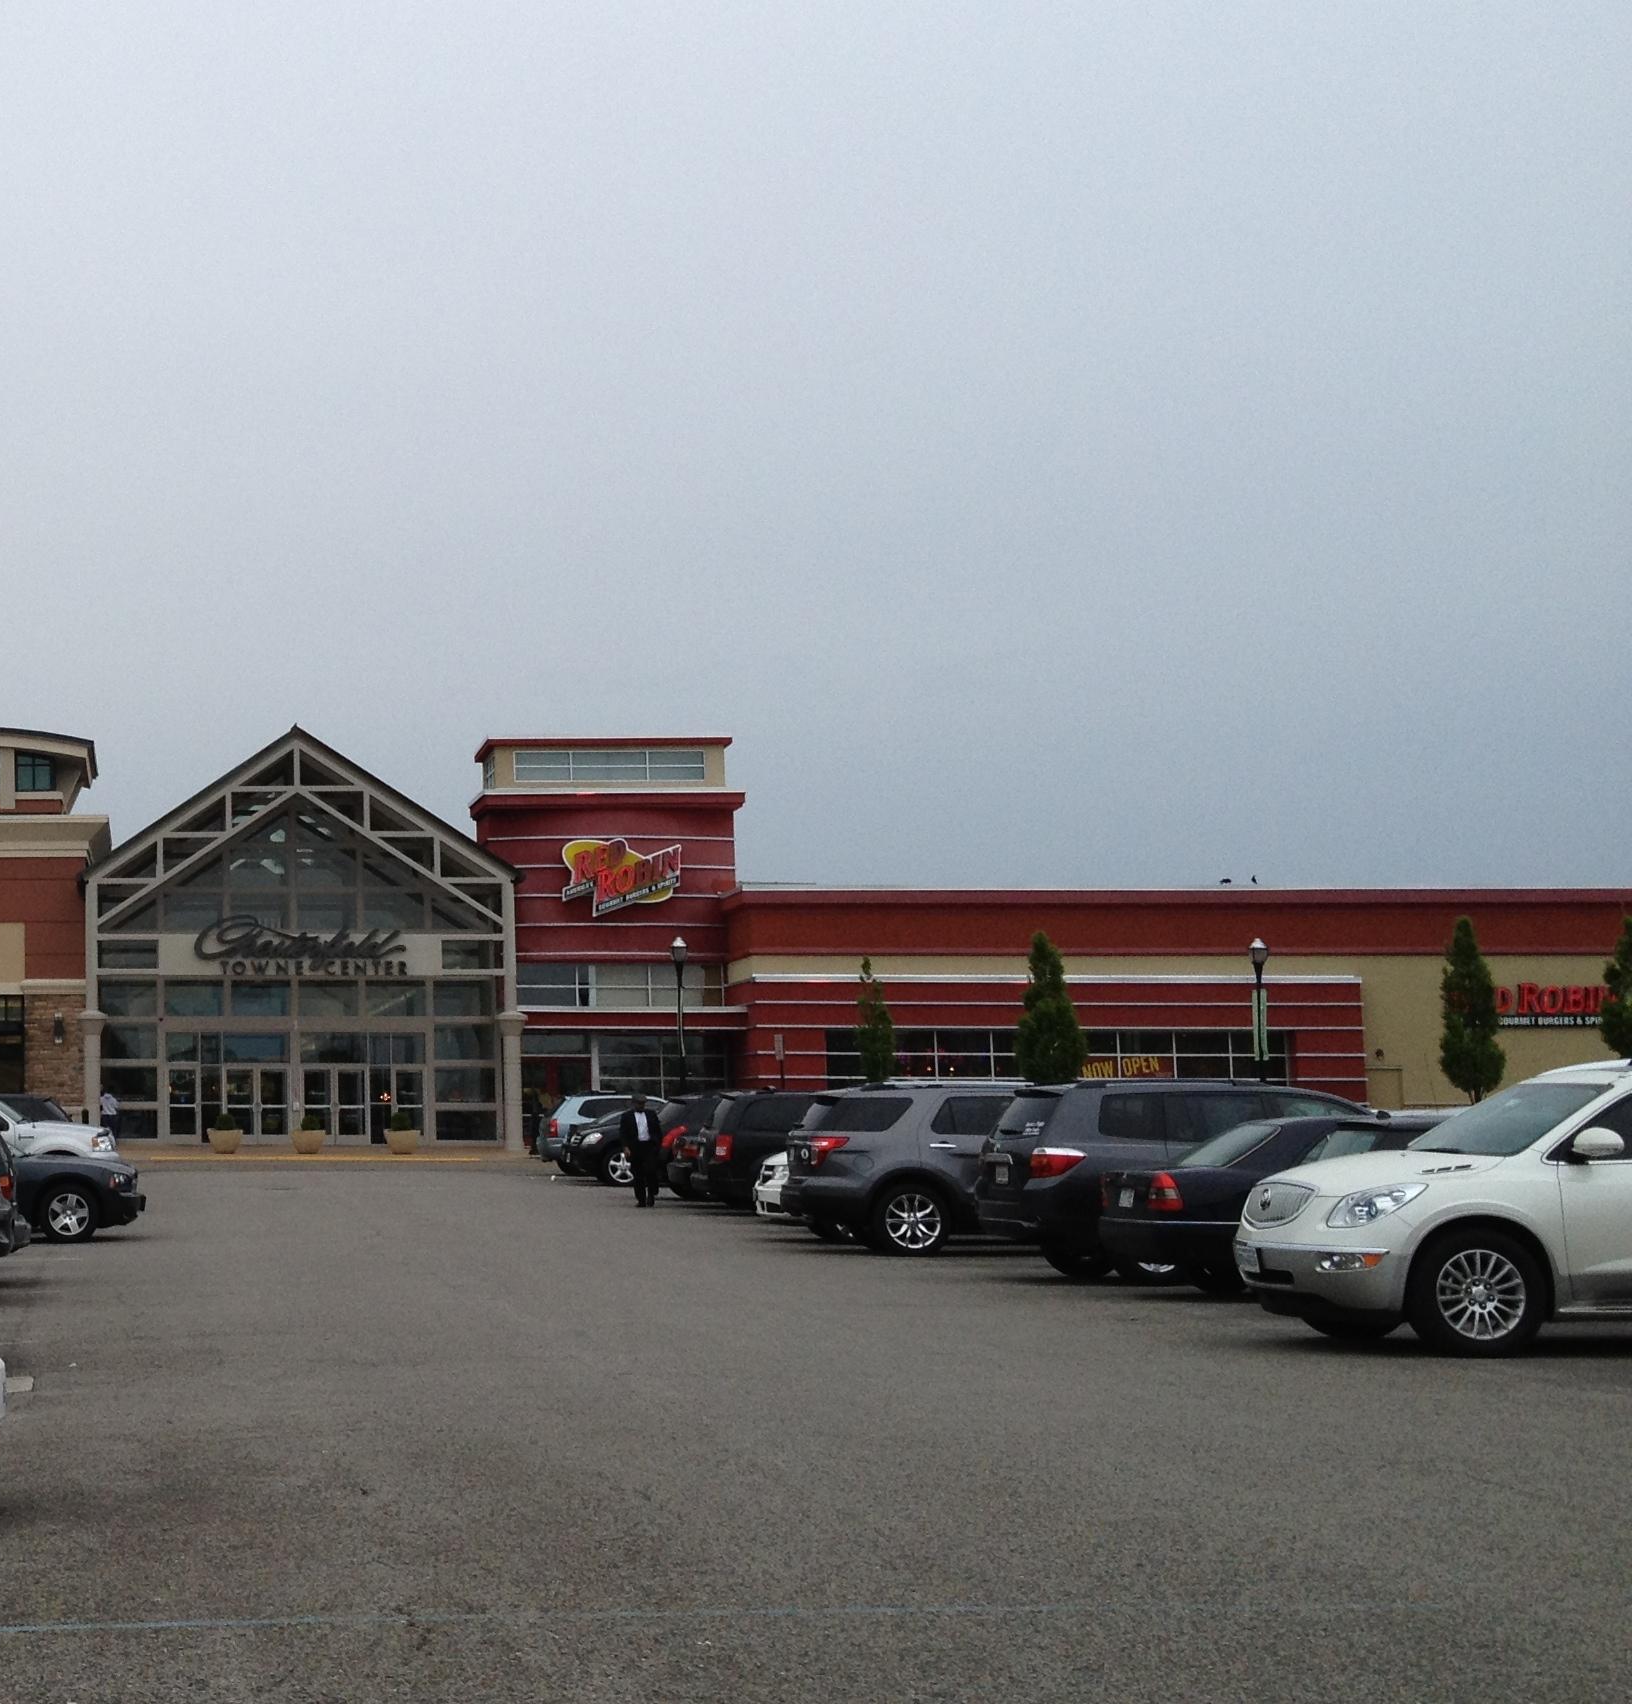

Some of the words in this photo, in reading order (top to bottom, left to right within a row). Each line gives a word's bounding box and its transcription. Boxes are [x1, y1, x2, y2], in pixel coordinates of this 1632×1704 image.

[574, 840, 627, 884] RED
[596, 849, 680, 904] ROBIN
[219, 959, 304, 977] TOWNE
[325, 959, 408, 977] CENTER
[1538, 1016, 1574, 1026] BURGERS
[1081, 1060, 1114, 1078] NOW
[1122, 1056, 1160, 1076] OPEN
